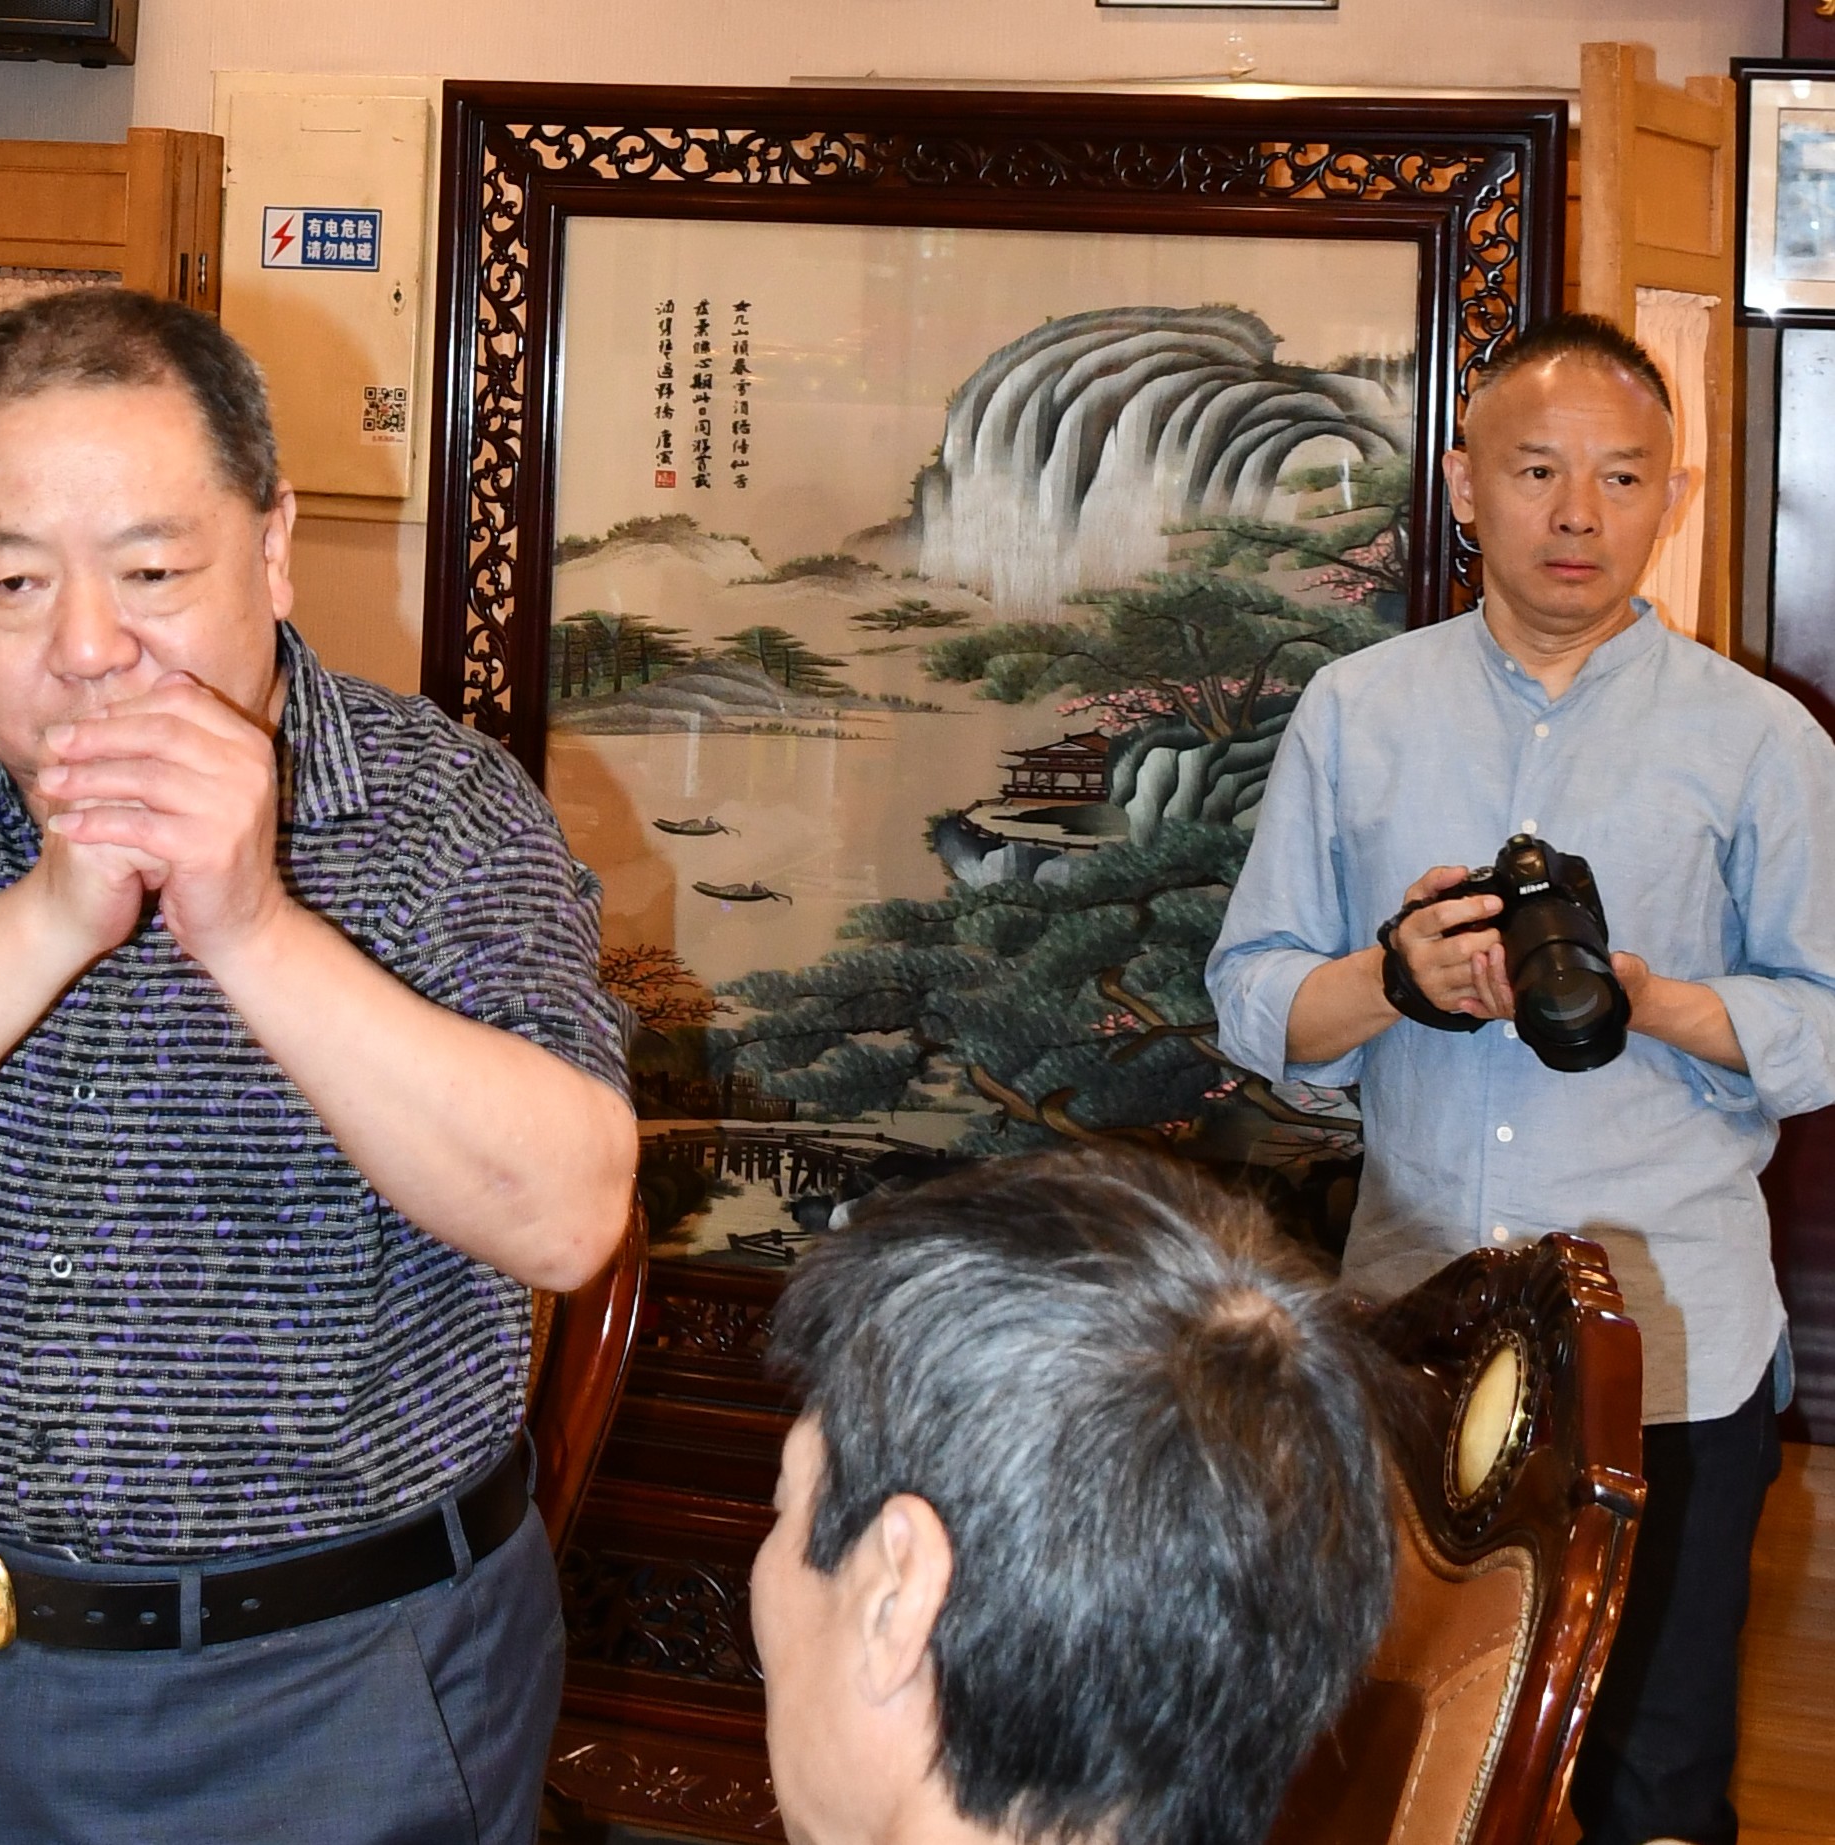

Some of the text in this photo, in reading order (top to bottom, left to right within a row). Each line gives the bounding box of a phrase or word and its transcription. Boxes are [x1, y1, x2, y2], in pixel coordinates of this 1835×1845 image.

[307, 218, 374, 239] 有电危险
[306, 240, 373, 262] 请勿触碰
[1519, 881, 1550, 895] Nikon
